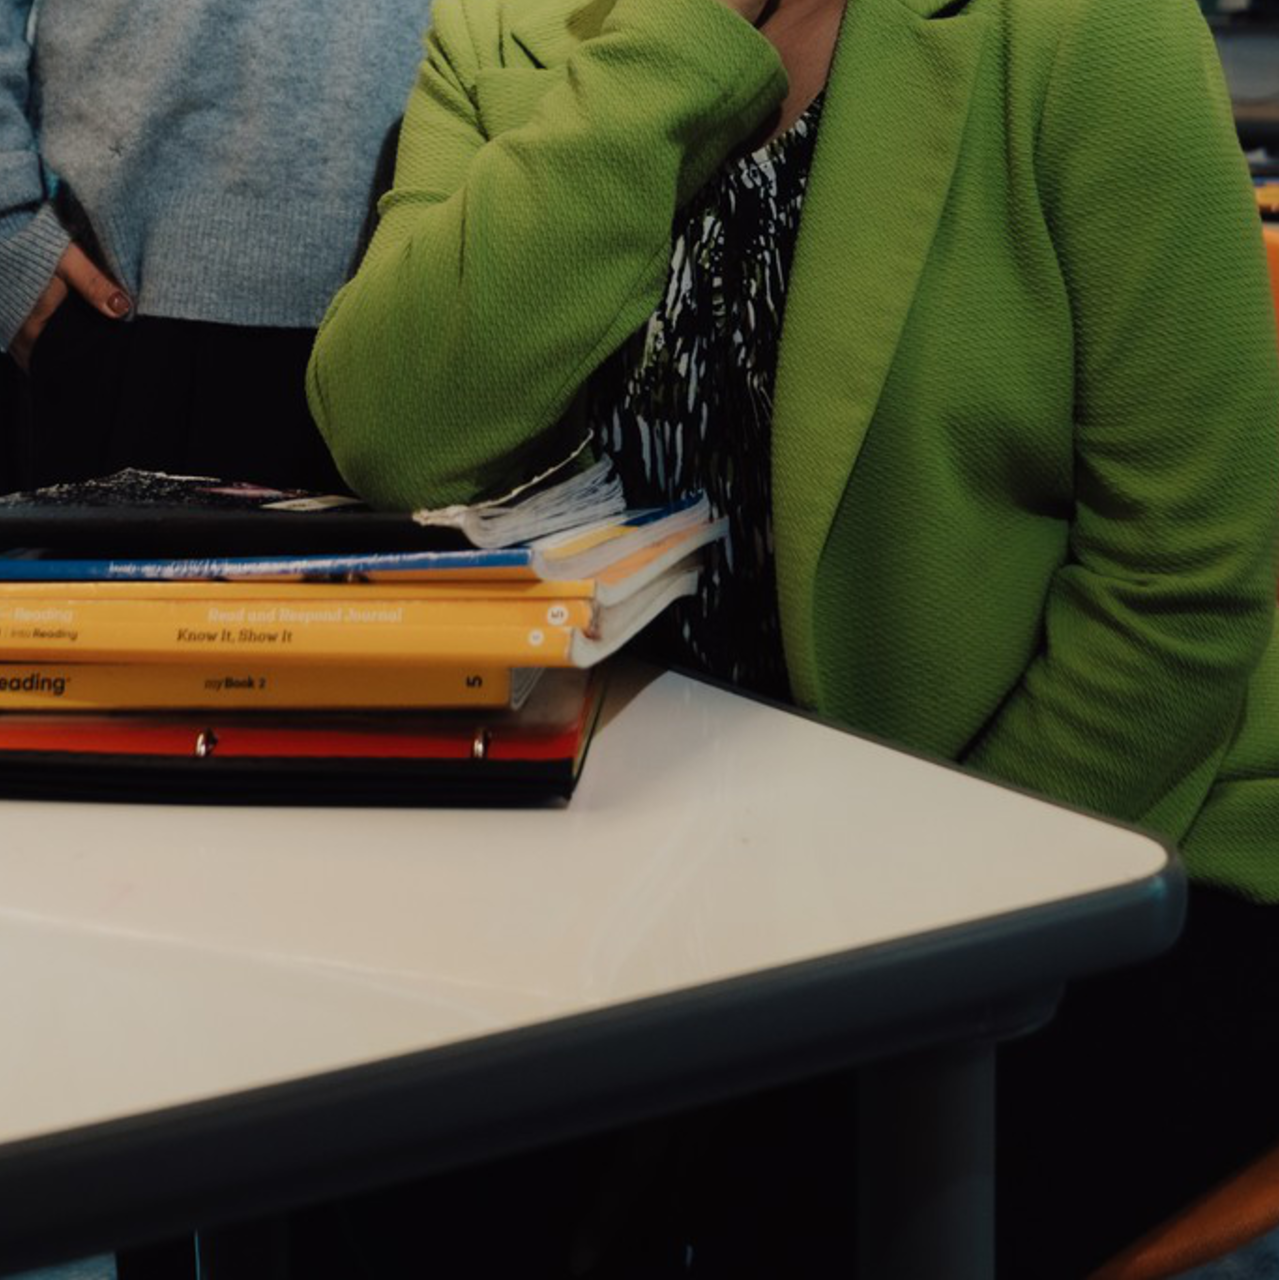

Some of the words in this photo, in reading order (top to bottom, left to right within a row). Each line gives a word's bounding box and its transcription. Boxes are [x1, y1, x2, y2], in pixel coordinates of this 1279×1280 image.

[207, 606, 245, 623] Read
[247, 607, 277, 623] and
[278, 606, 342, 626] Respond
[346, 606, 404, 624] Journal
[32, 626, 79, 642] Reading
[176, 628, 218, 643] Know
[220, 628, 236, 645] It,
[238, 628, 274, 643] Show
[278, 628, 293, 643] It
[465, 676, 482, 688] 5
